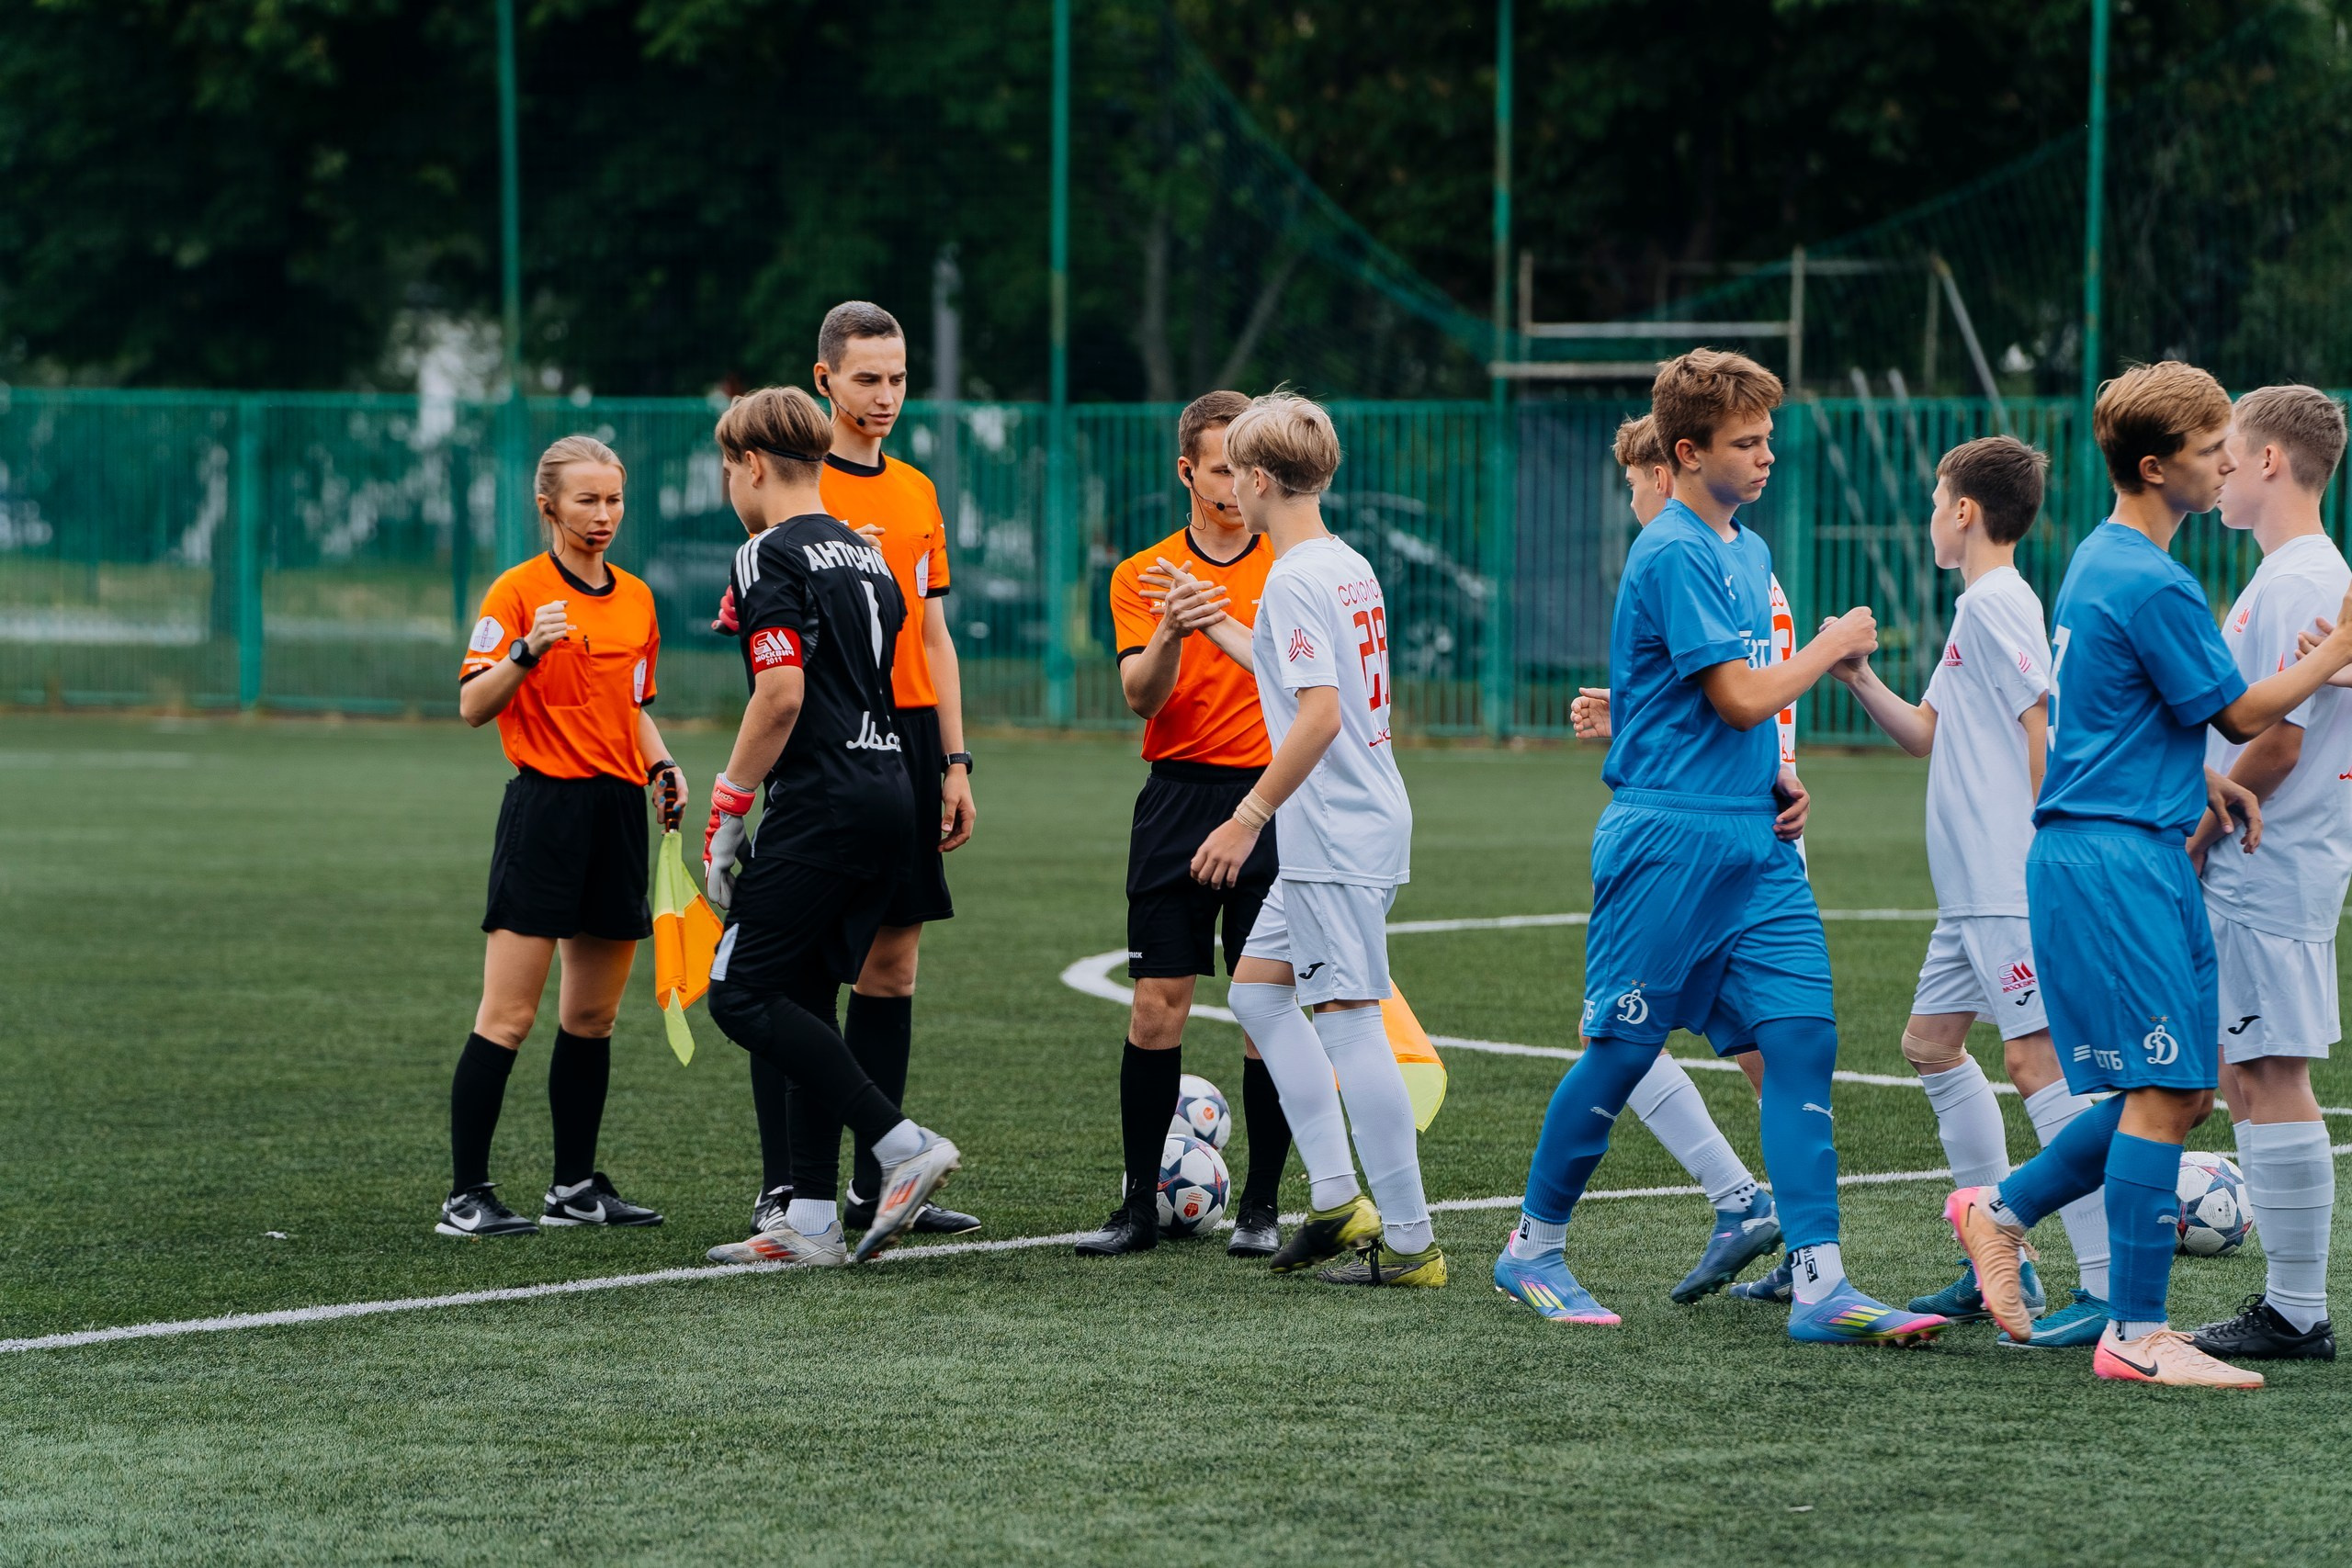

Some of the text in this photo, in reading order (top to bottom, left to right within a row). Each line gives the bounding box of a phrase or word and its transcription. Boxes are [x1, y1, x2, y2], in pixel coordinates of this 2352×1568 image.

[1338, 578, 1383, 607] СОКОЛО
[755, 649, 795, 663] МОСКВИЧ
[766, 656, 783, 666] 2011
